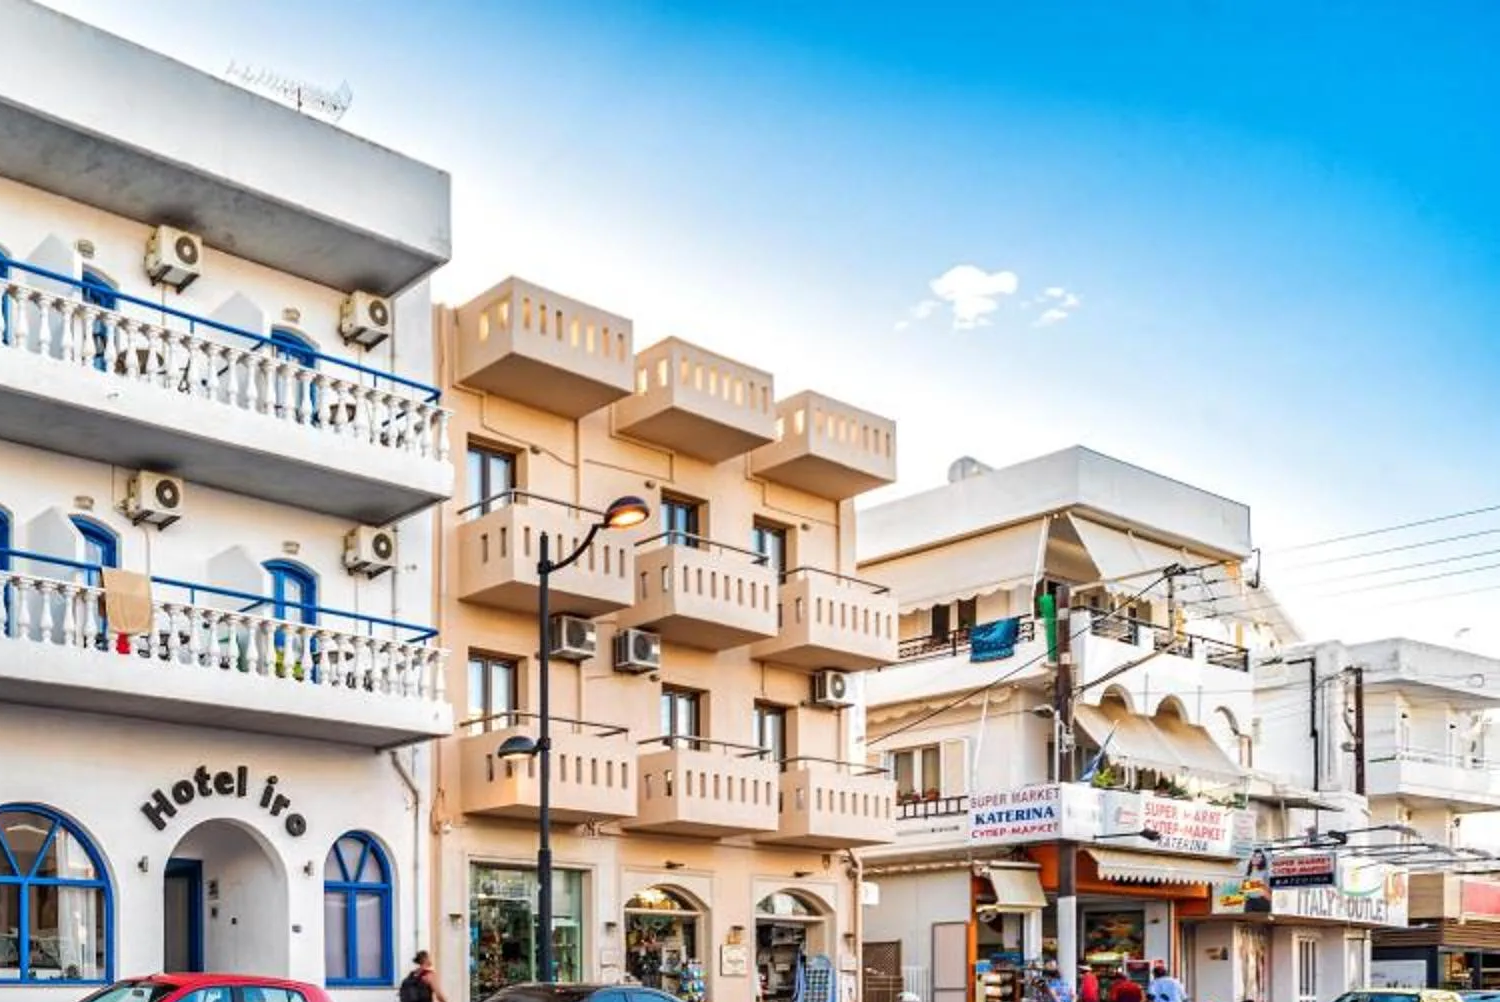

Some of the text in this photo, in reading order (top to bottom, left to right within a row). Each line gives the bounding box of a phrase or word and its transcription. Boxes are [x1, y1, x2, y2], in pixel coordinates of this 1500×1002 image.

[140, 765, 307, 837] Hotel iro
[971, 788, 1060, 809] SUPER MARKET
[975, 806, 1055, 825] KATERINA
[1144, 803, 1177, 818] SUPER
